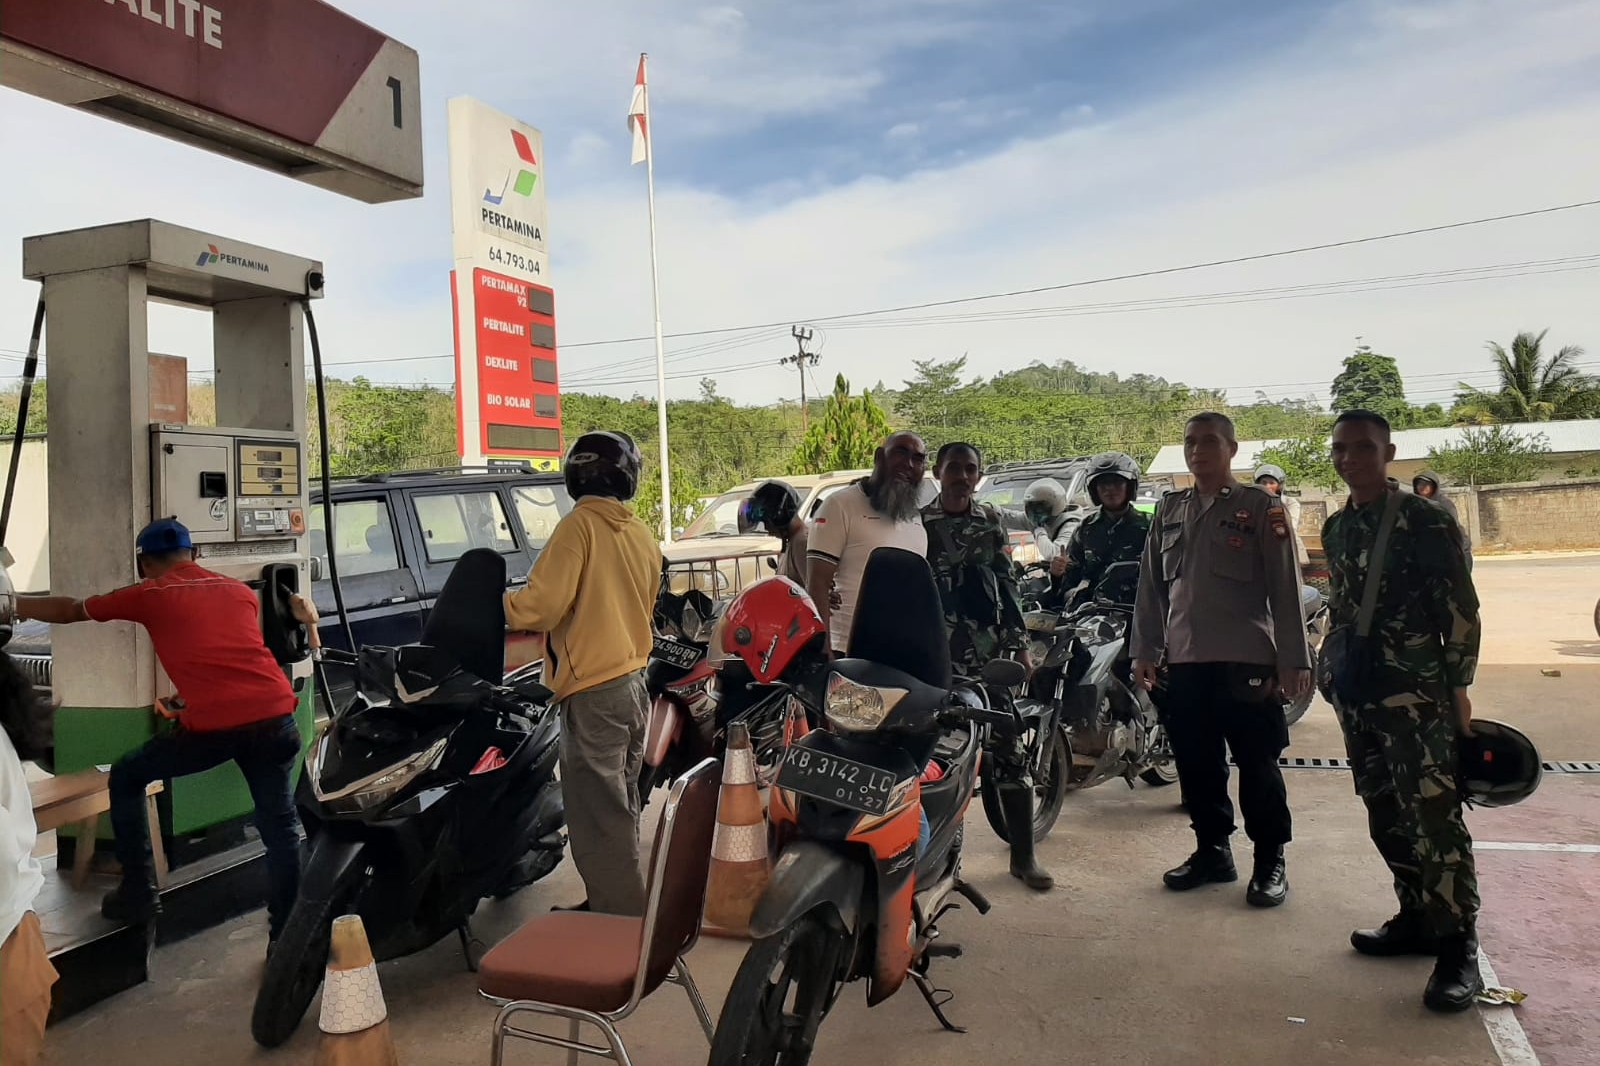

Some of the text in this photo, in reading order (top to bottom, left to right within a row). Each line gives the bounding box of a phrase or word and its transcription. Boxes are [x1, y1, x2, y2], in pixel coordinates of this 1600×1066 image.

[386, 76, 402, 129] 1
[482, 207, 542, 241] PERTAMINA
[220, 253, 269, 272] PERTAMINA
[489, 246, 540, 275] 64.793.04
[482, 275, 526, 296] PERTAMAX
[517, 296, 527, 308] 92
[483, 317, 525, 336] PERTALITE
[485, 355, 518, 371] DEXLITE
[487, 393, 531, 409] BIO SOLAR
[786, 749, 892, 793] KB 3142 LC
